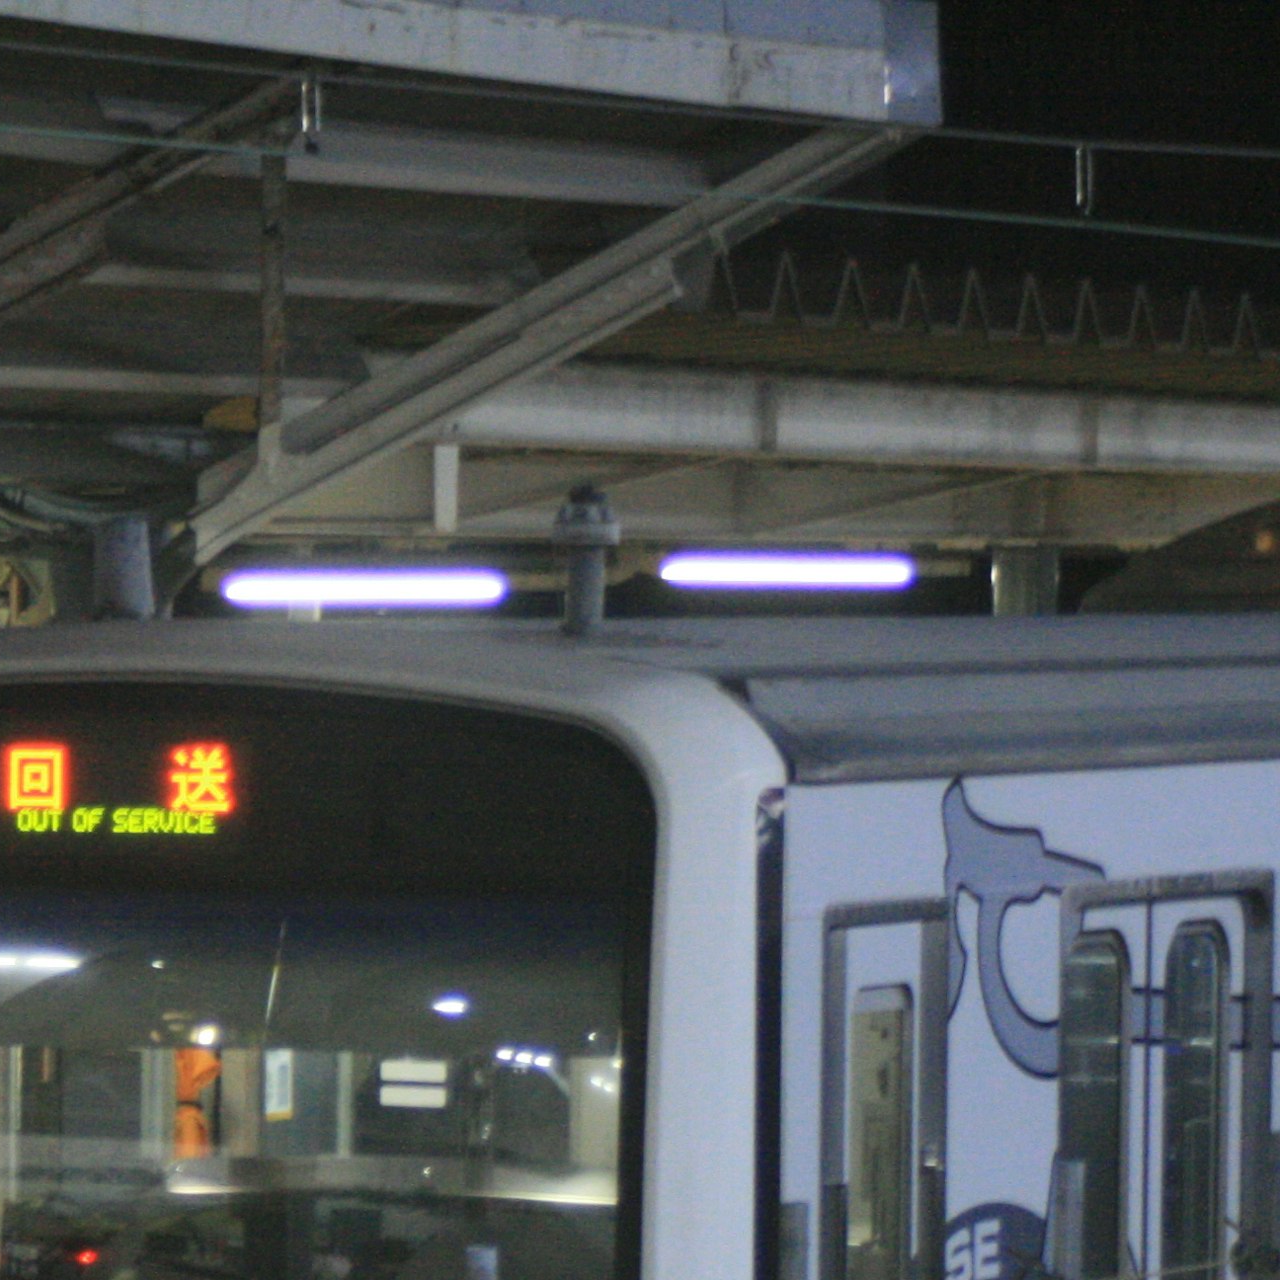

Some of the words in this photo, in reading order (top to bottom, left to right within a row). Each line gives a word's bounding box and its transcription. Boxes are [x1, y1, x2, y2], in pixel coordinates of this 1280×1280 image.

[8, 746, 230, 812] 回送
[16, 807, 64, 833] OUT
[71, 807, 106, 833] OF
[112, 807, 217, 834] SERVICE
